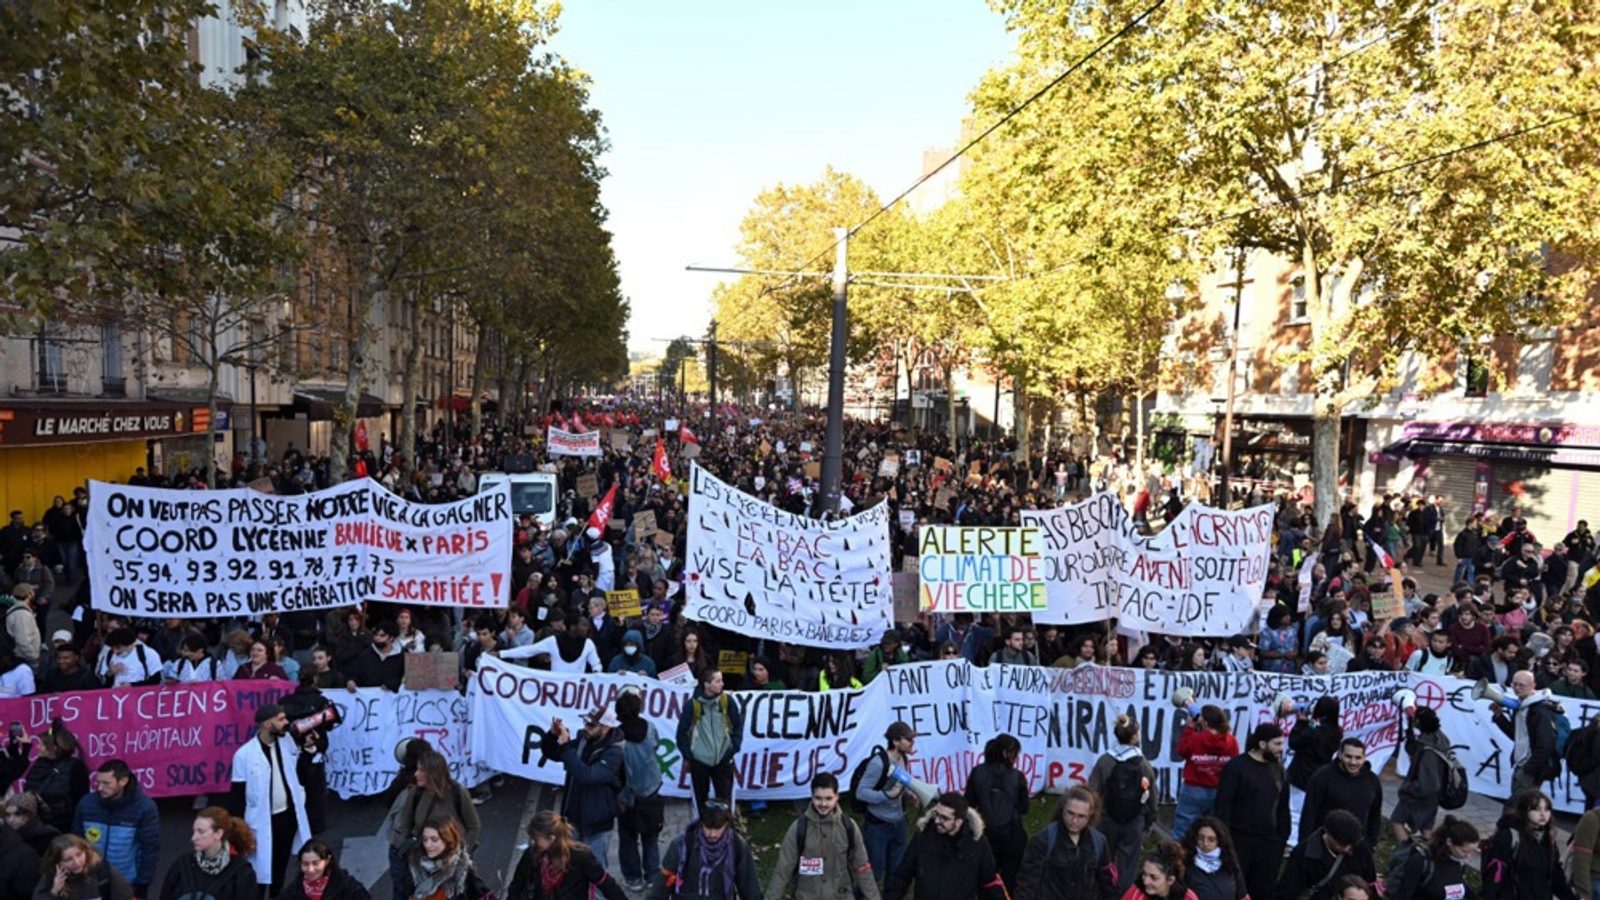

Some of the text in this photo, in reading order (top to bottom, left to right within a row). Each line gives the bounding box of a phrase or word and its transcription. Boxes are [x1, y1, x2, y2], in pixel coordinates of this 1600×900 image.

[36, 412, 170, 435] LE MARCHÉ CHEZ VOUS
[694, 468, 720, 500] LES
[107, 492, 144, 519] ON
[149, 499, 190, 521] VEUT
[191, 499, 222, 523] PAS
[228, 498, 300, 525] PASSER
[306, 488, 369, 521] NOTRE
[433, 492, 509, 526] GAGNER
[116, 525, 217, 553] COORD
[232, 525, 327, 552] LYCÉENNE
[777, 529, 831, 559] BAC
[921, 527, 1039, 556] ALERTE
[737, 540, 825, 579] LA BAC
[921, 556, 1042, 582] CLIMAT DE
[1195, 557, 1235, 581] SOIT
[694, 552, 876, 604] VISE LA TÊTE
[109, 585, 137, 610] ON
[144, 588, 197, 613] SERA
[205, 592, 242, 613] PAS
[247, 590, 278, 613] UNE
[924, 580, 1047, 610] VIE CHÈRE
[698, 604, 747, 627] COORD
[753, 616, 793, 637] PARIS
[478, 666, 689, 719] COORDINAION
[886, 665, 932, 696] TANT
[30, 696, 82, 728] DES
[88, 732, 118, 757] DES
[125, 724, 202, 756] HÔPITAUX
[167, 763, 207, 787] SOUS
